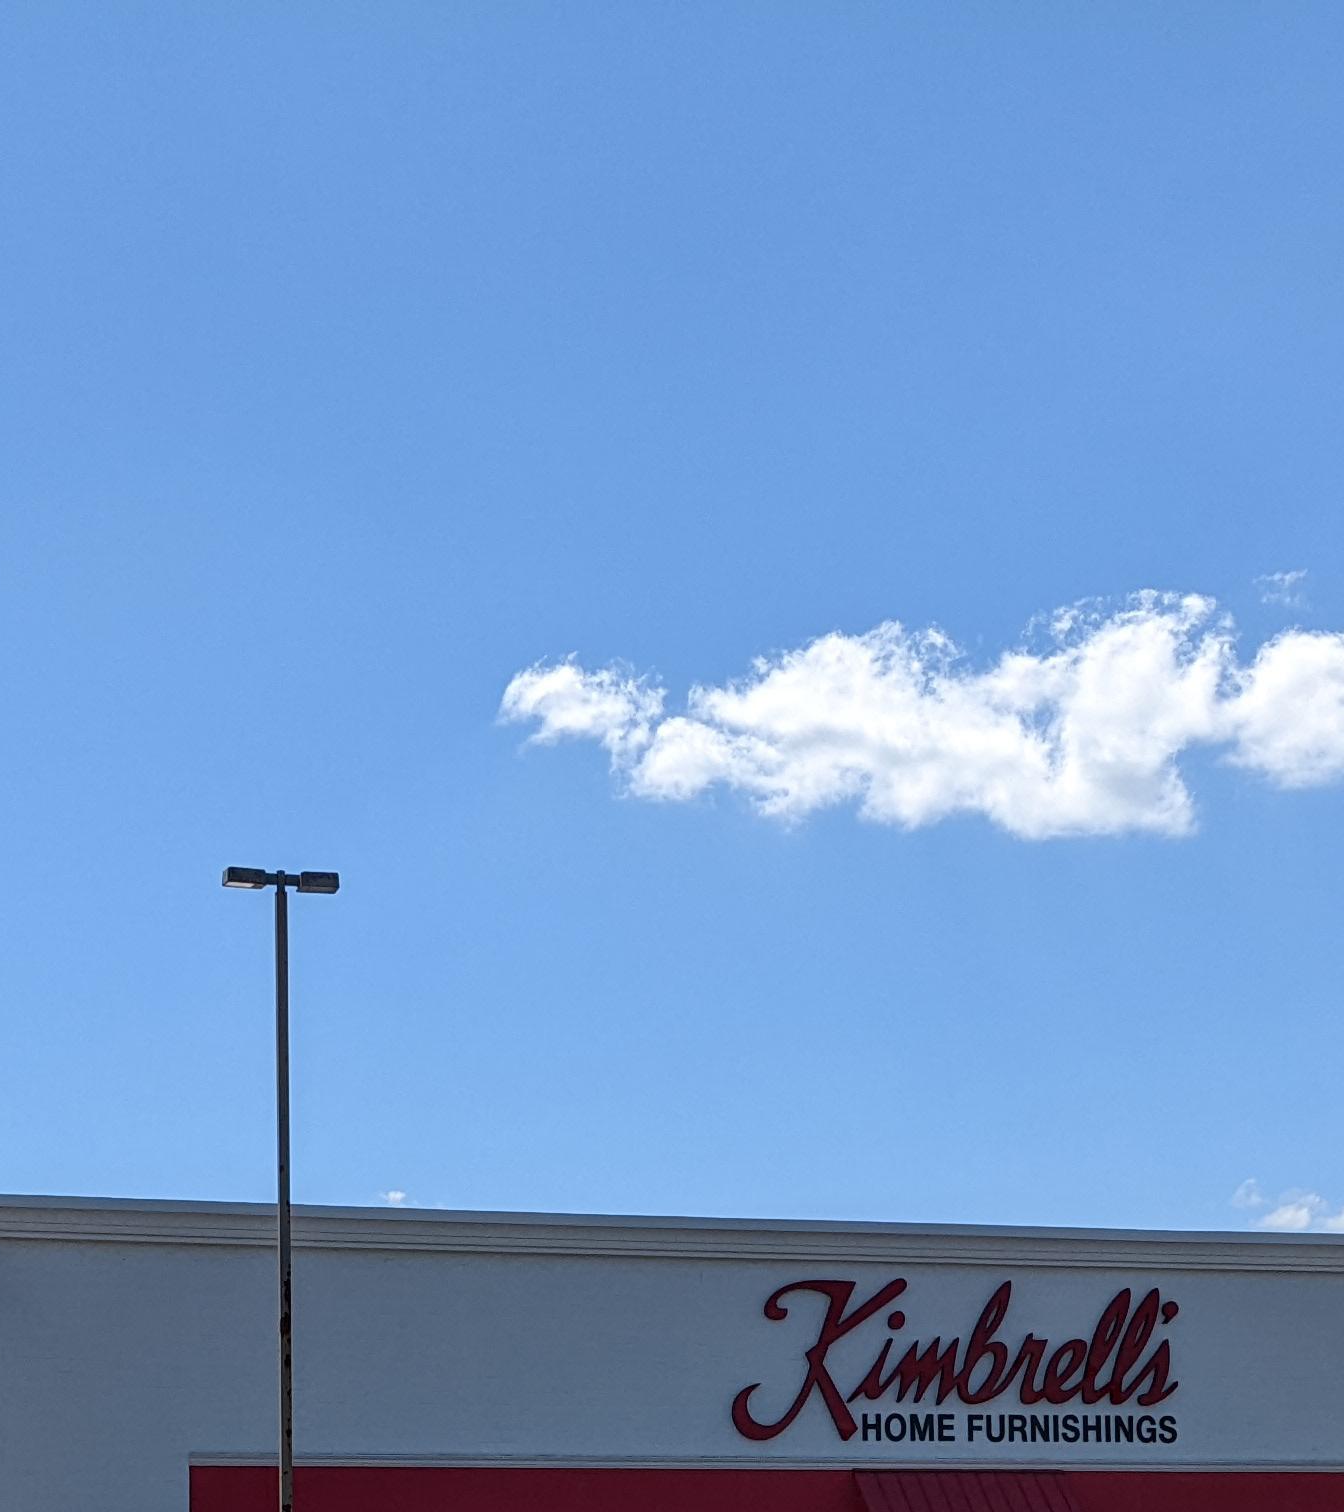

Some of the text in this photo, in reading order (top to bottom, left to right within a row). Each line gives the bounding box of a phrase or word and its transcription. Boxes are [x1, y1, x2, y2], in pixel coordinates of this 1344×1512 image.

[731, 1278, 1179, 1441] Kimbrell's
[862, 1413, 1178, 1444] HOME FURNISHINGS
